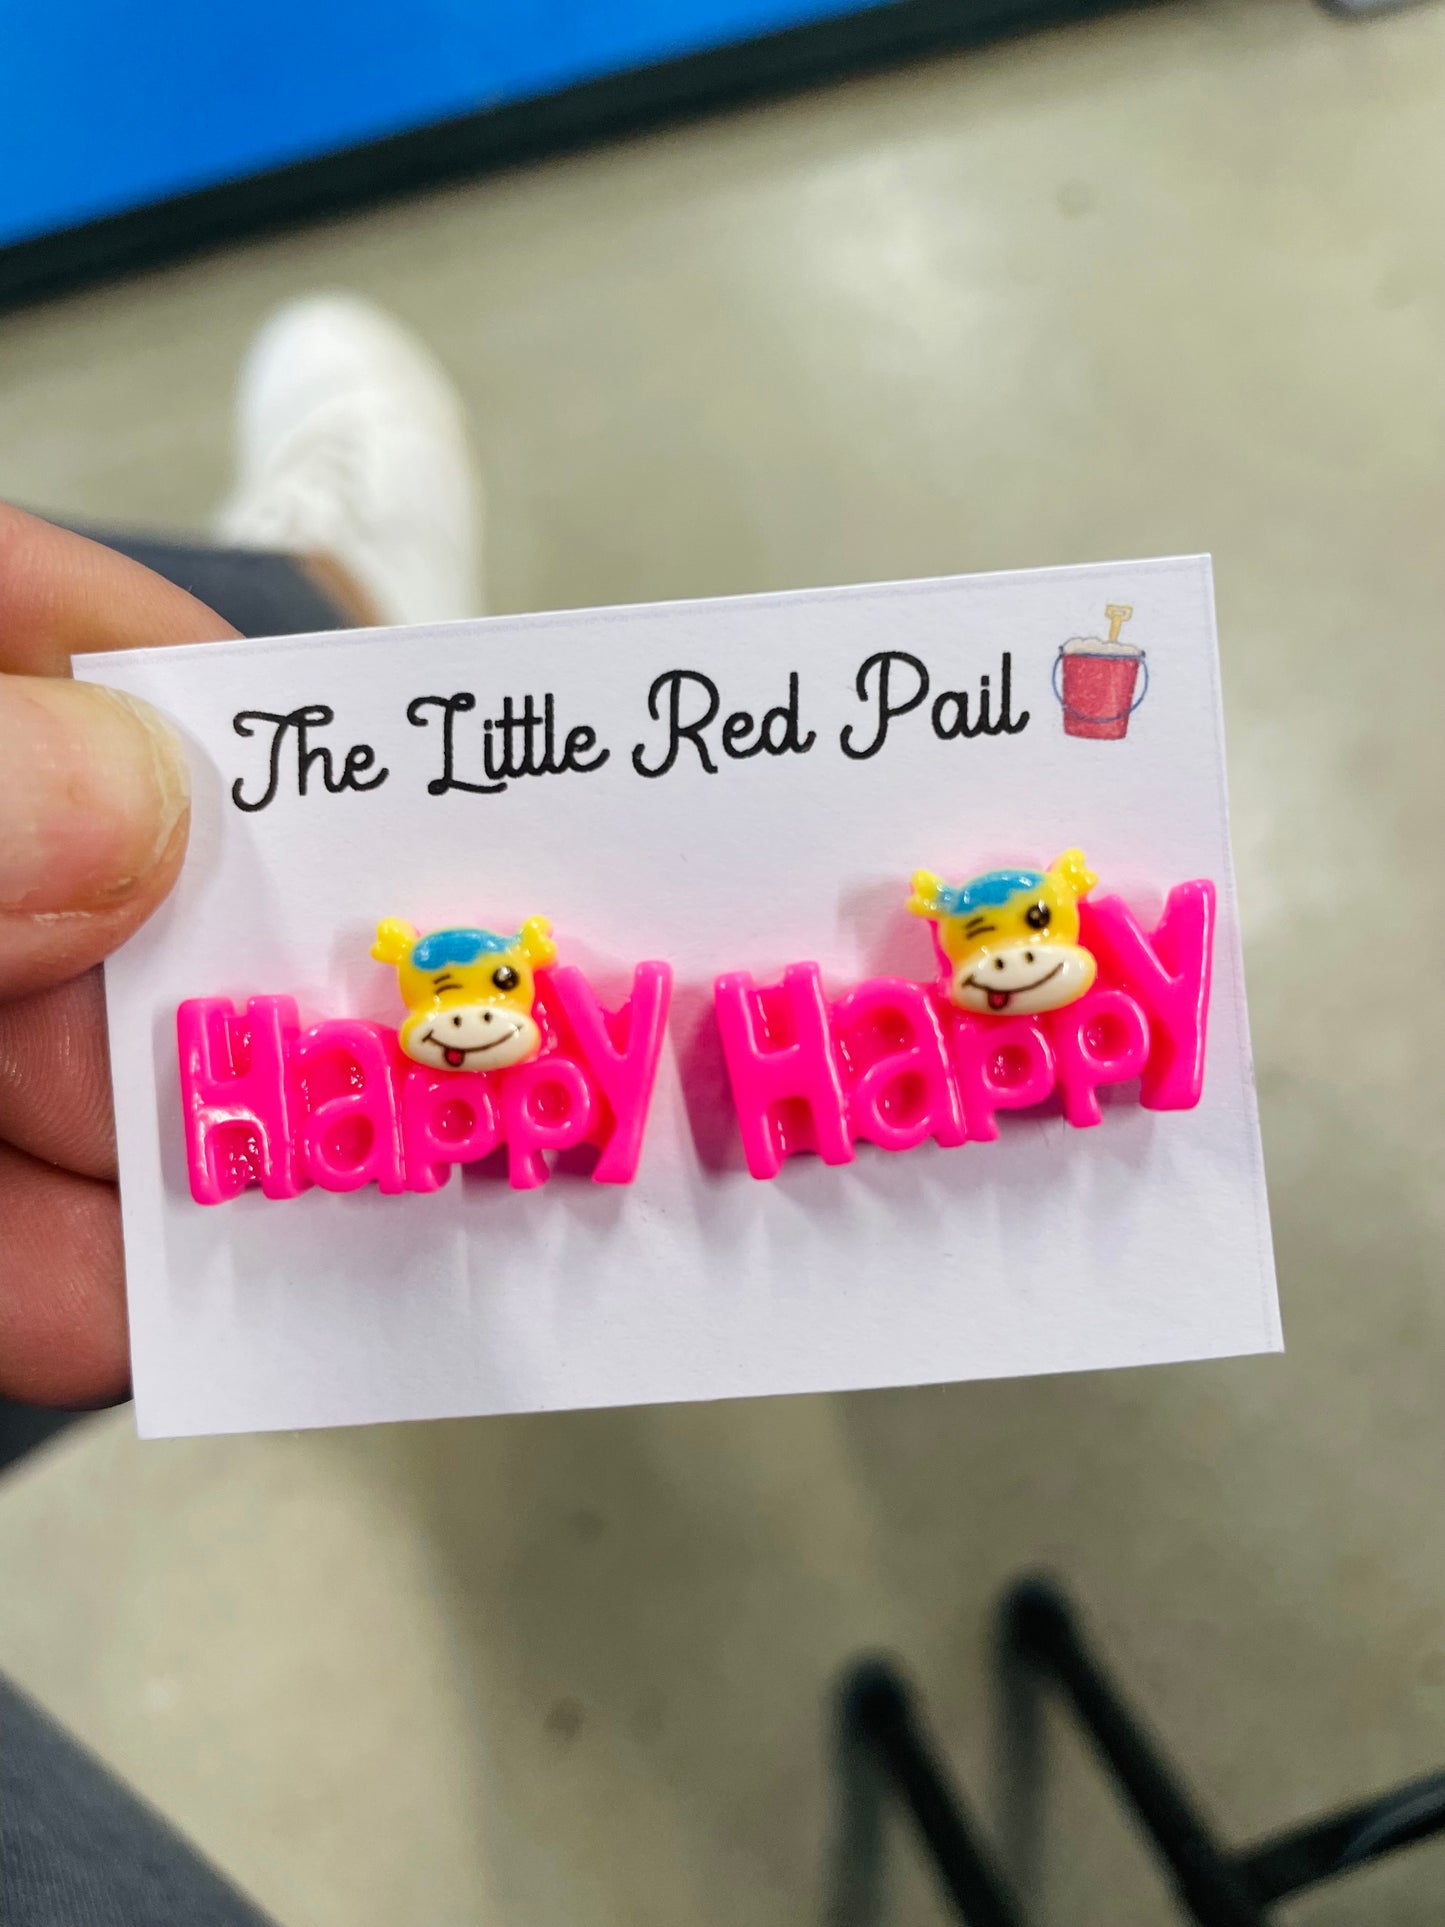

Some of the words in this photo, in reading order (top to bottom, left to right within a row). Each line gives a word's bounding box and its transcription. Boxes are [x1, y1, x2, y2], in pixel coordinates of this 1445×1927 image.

[232, 705, 388, 812] The
[407, 693, 609, 795] Little
[632, 670, 816, 778] Red
[840, 651, 1029, 759] Pail
[177, 960, 672, 1206] Happy
[714, 879, 1216, 1180] Happy
